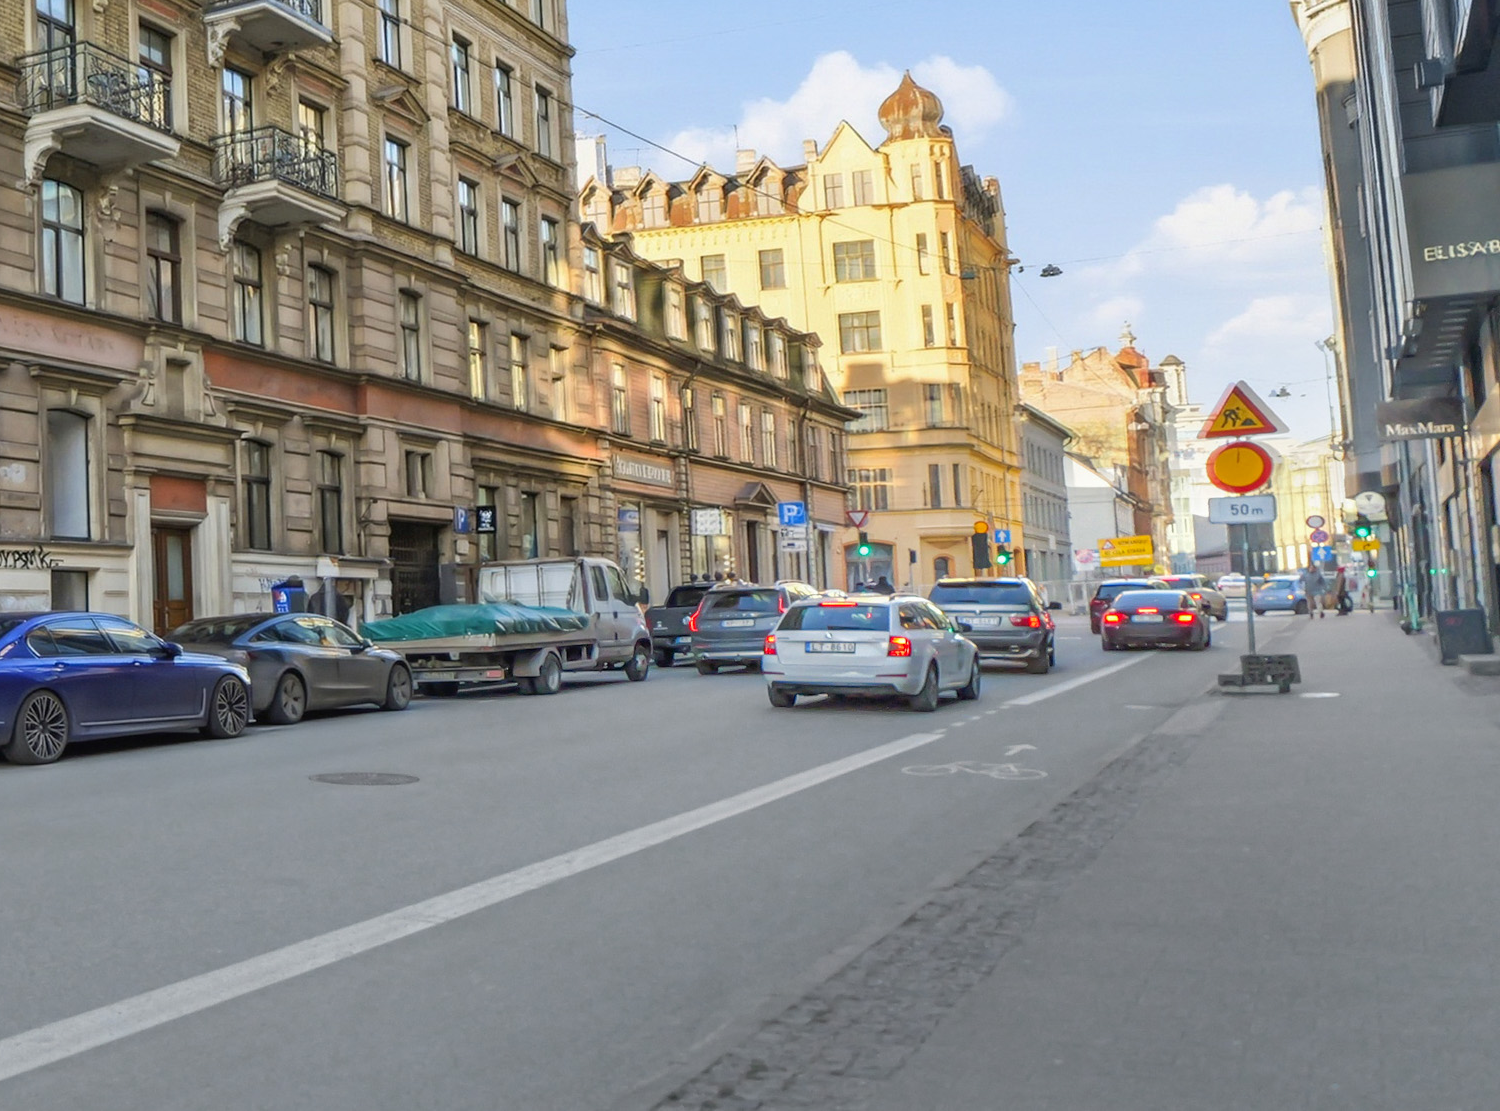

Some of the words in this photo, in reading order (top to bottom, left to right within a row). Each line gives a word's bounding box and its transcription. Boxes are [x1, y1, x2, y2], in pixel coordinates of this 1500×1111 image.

[1385, 421, 1455, 437] MaxMara
[783, 504, 798, 523] P
[1230, 503, 1249, 516] 50
[1251, 507, 1263, 515] m
